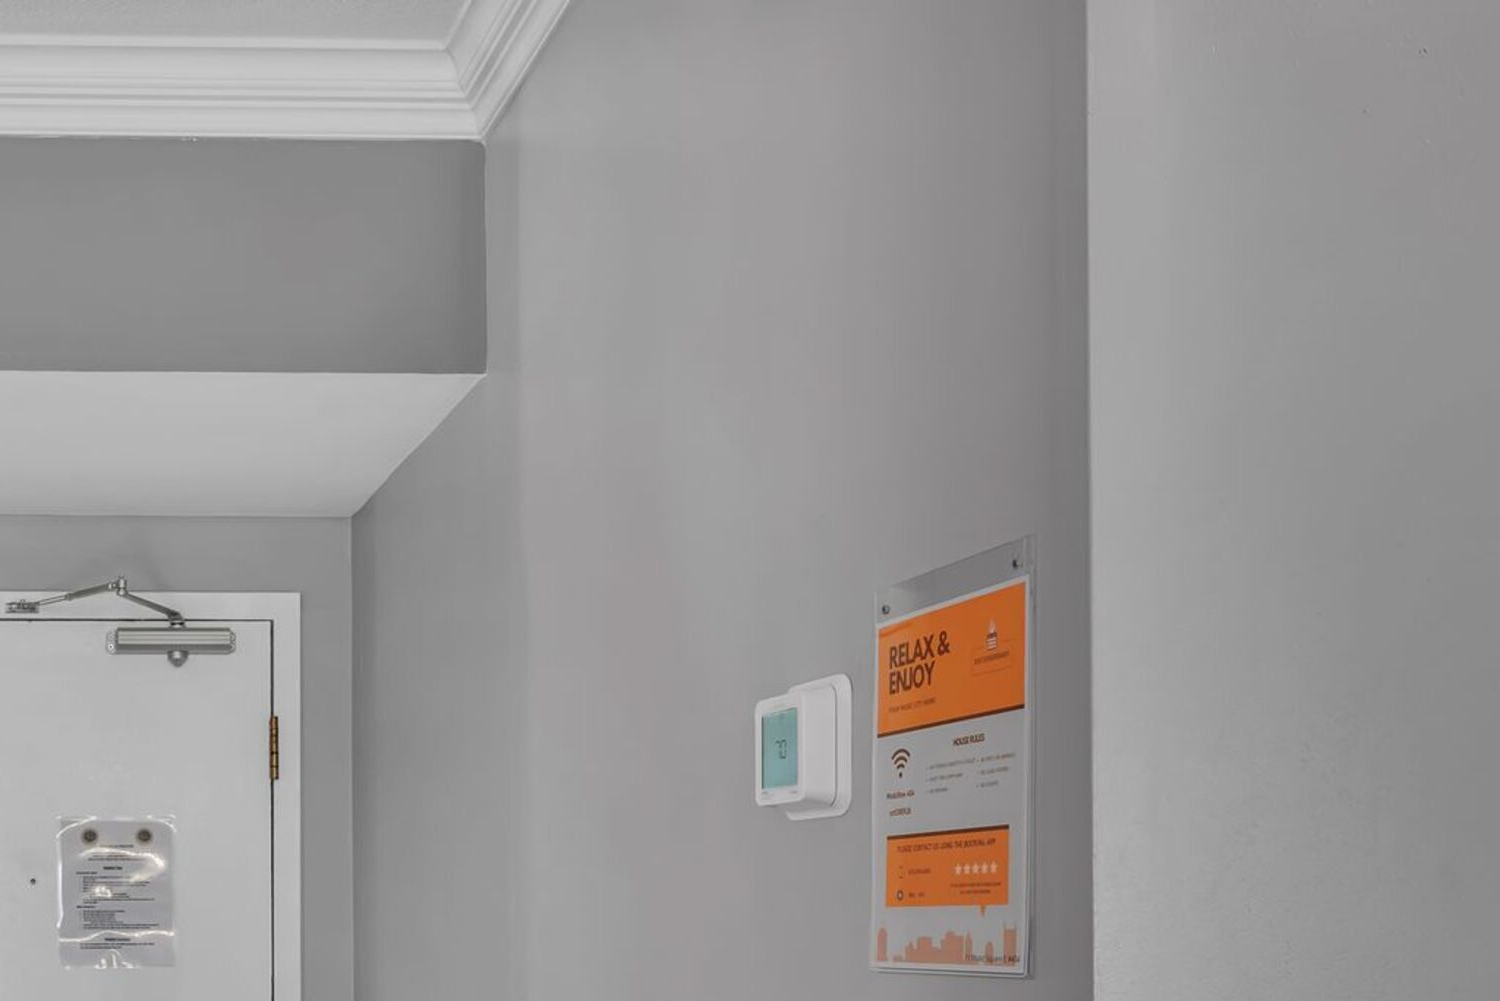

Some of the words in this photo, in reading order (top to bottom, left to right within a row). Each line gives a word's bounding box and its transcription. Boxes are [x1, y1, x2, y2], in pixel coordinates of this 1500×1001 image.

[889, 634, 934, 670] RELAX
[938, 630, 950, 656] &
[889, 661, 936, 695] ENJOY
